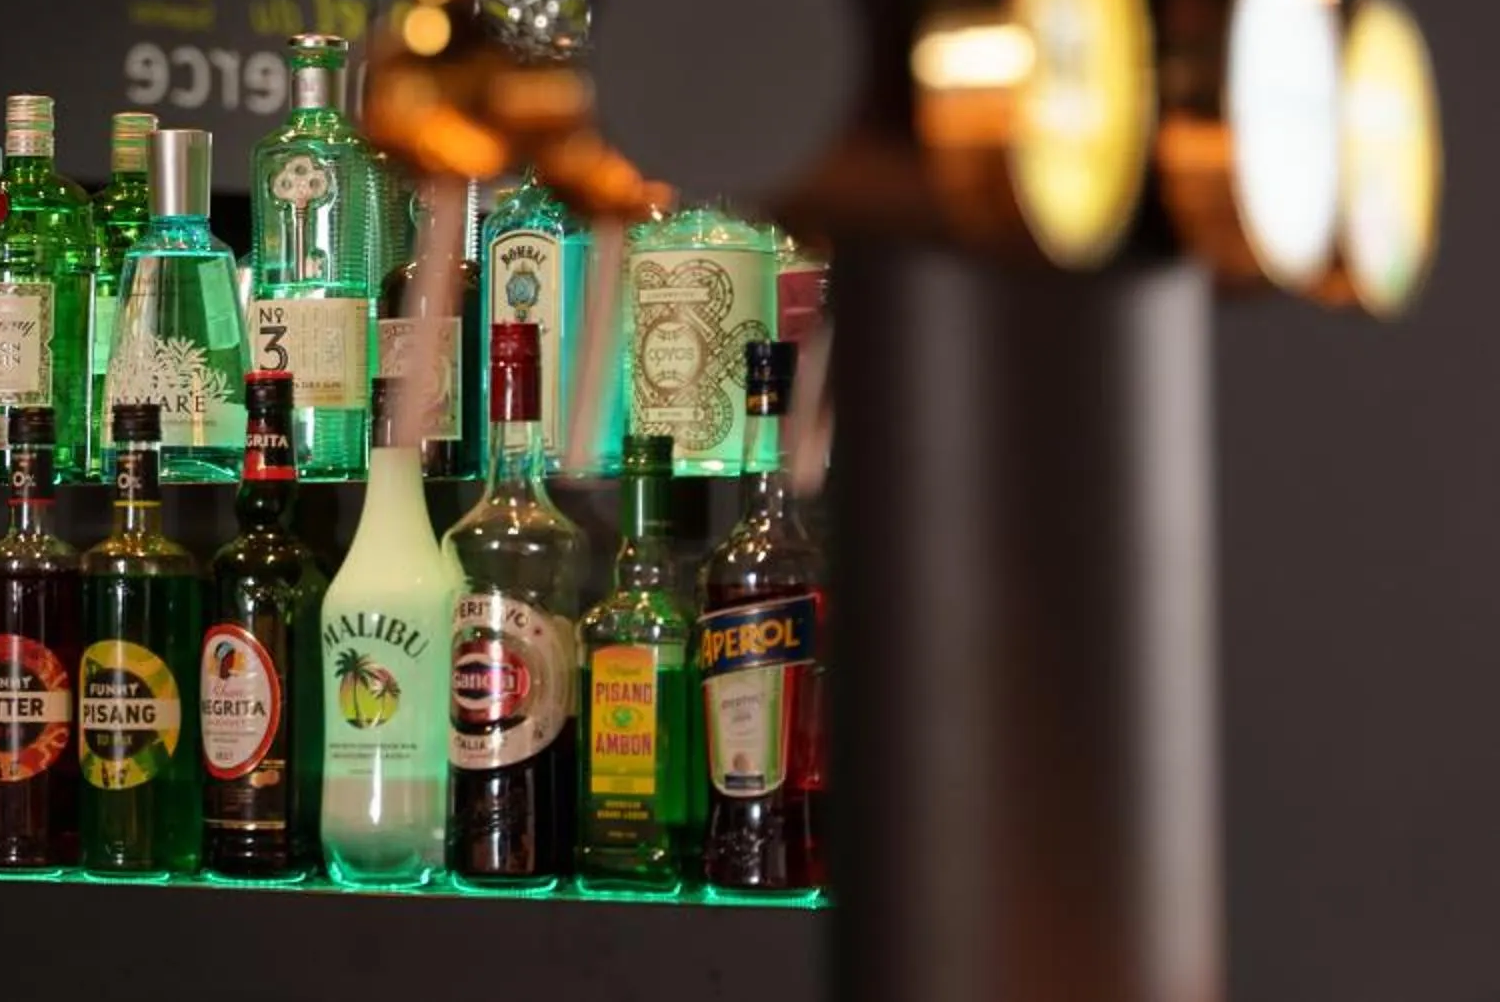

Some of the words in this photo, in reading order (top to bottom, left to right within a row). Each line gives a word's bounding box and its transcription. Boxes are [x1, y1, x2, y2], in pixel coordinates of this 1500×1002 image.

[259, 325, 289, 371] 3
[322, 611, 431, 661] MALIBU
[700, 618, 800, 669] APEROL
[89, 682, 140, 697] FUNNY
[595, 681, 653, 705] PISANG
[83, 703, 157, 724] PISANG
[595, 732, 653, 756] AMBON
